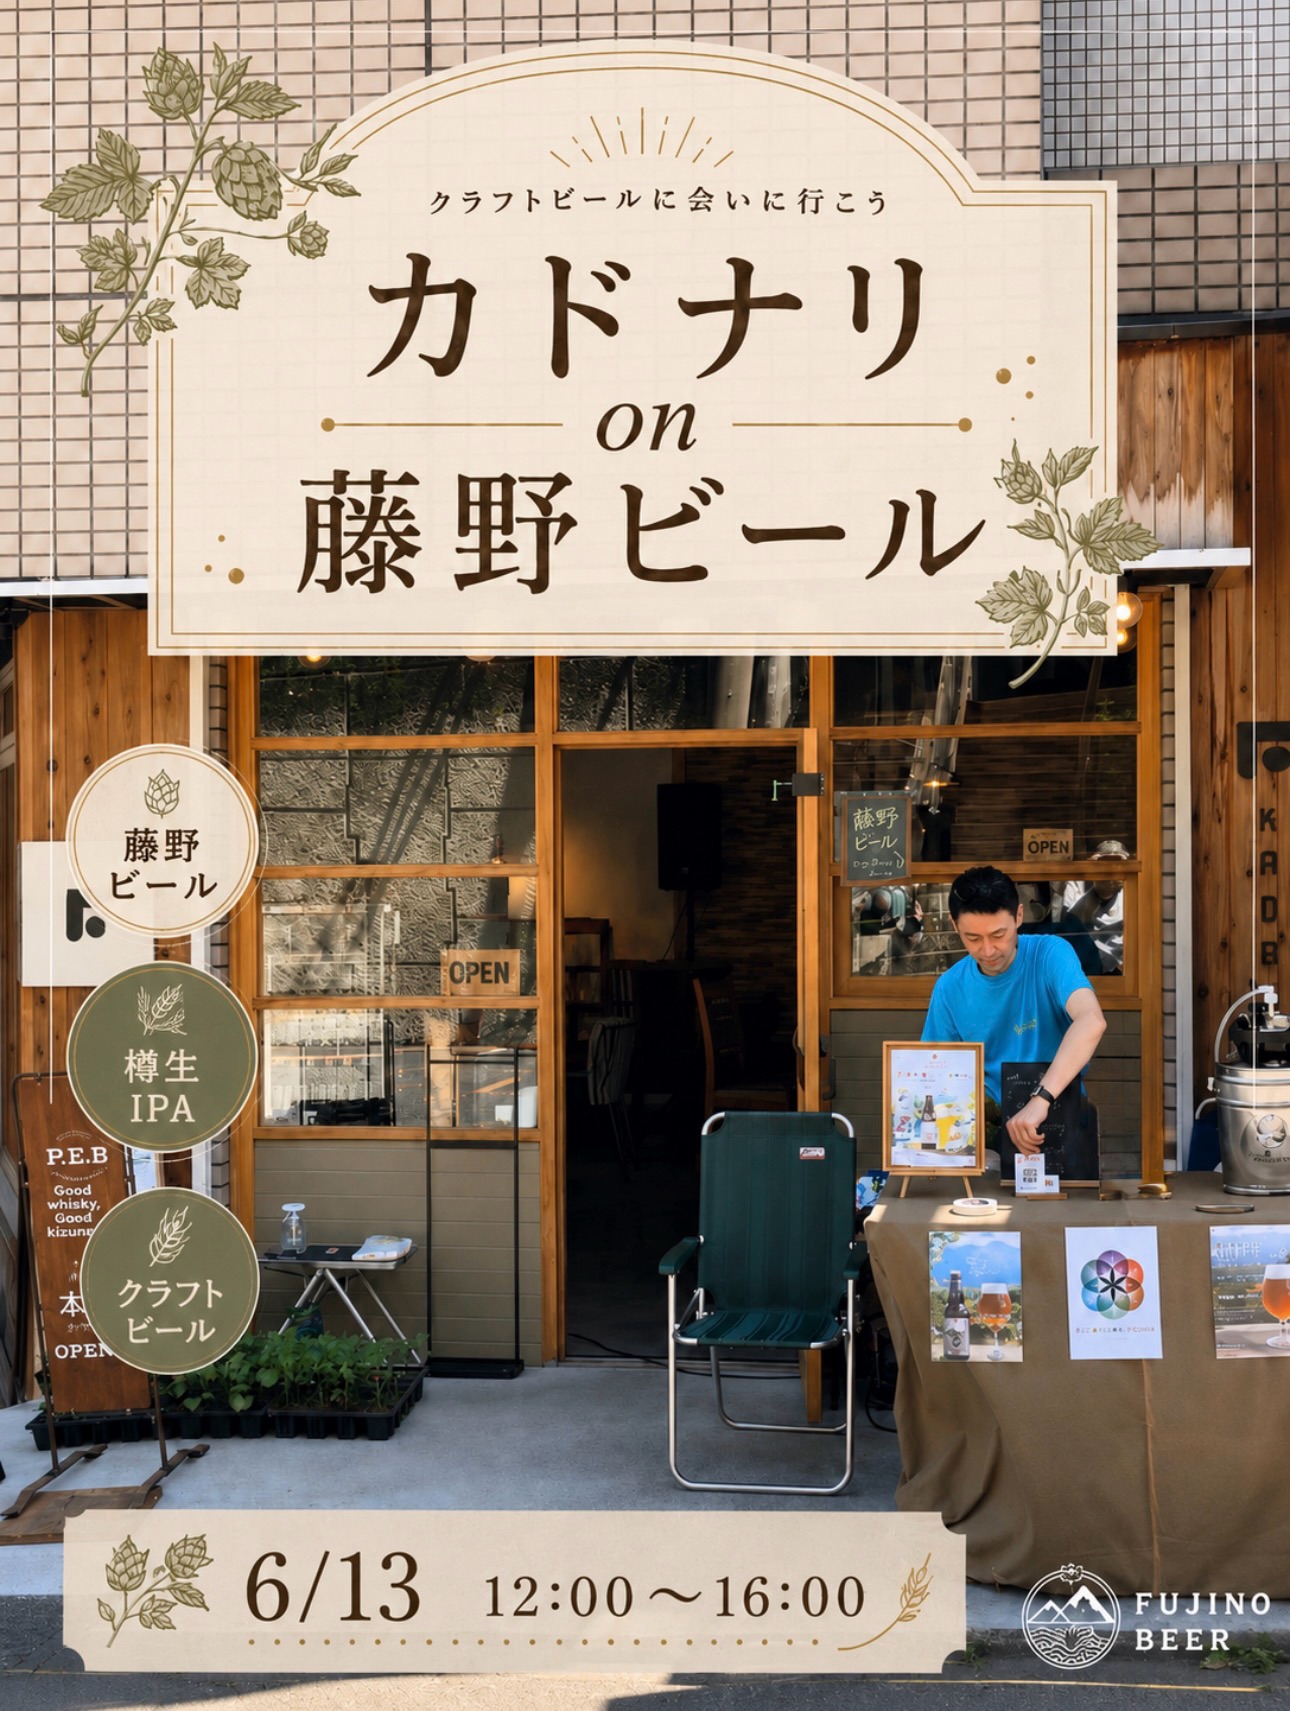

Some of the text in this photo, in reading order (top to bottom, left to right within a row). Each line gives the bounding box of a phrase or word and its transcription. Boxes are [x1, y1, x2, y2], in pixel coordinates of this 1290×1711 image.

[855, 832, 898, 852] ビール
[1028, 840, 1069, 854] OPEN
[449, 961, 510, 985] OPEN
[45, 1146, 108, 1166] P.E.B
[53, 1184, 92, 1196] Good
[47, 1197, 101, 1212] whisky,
[54, 1212, 93, 1223] Good
